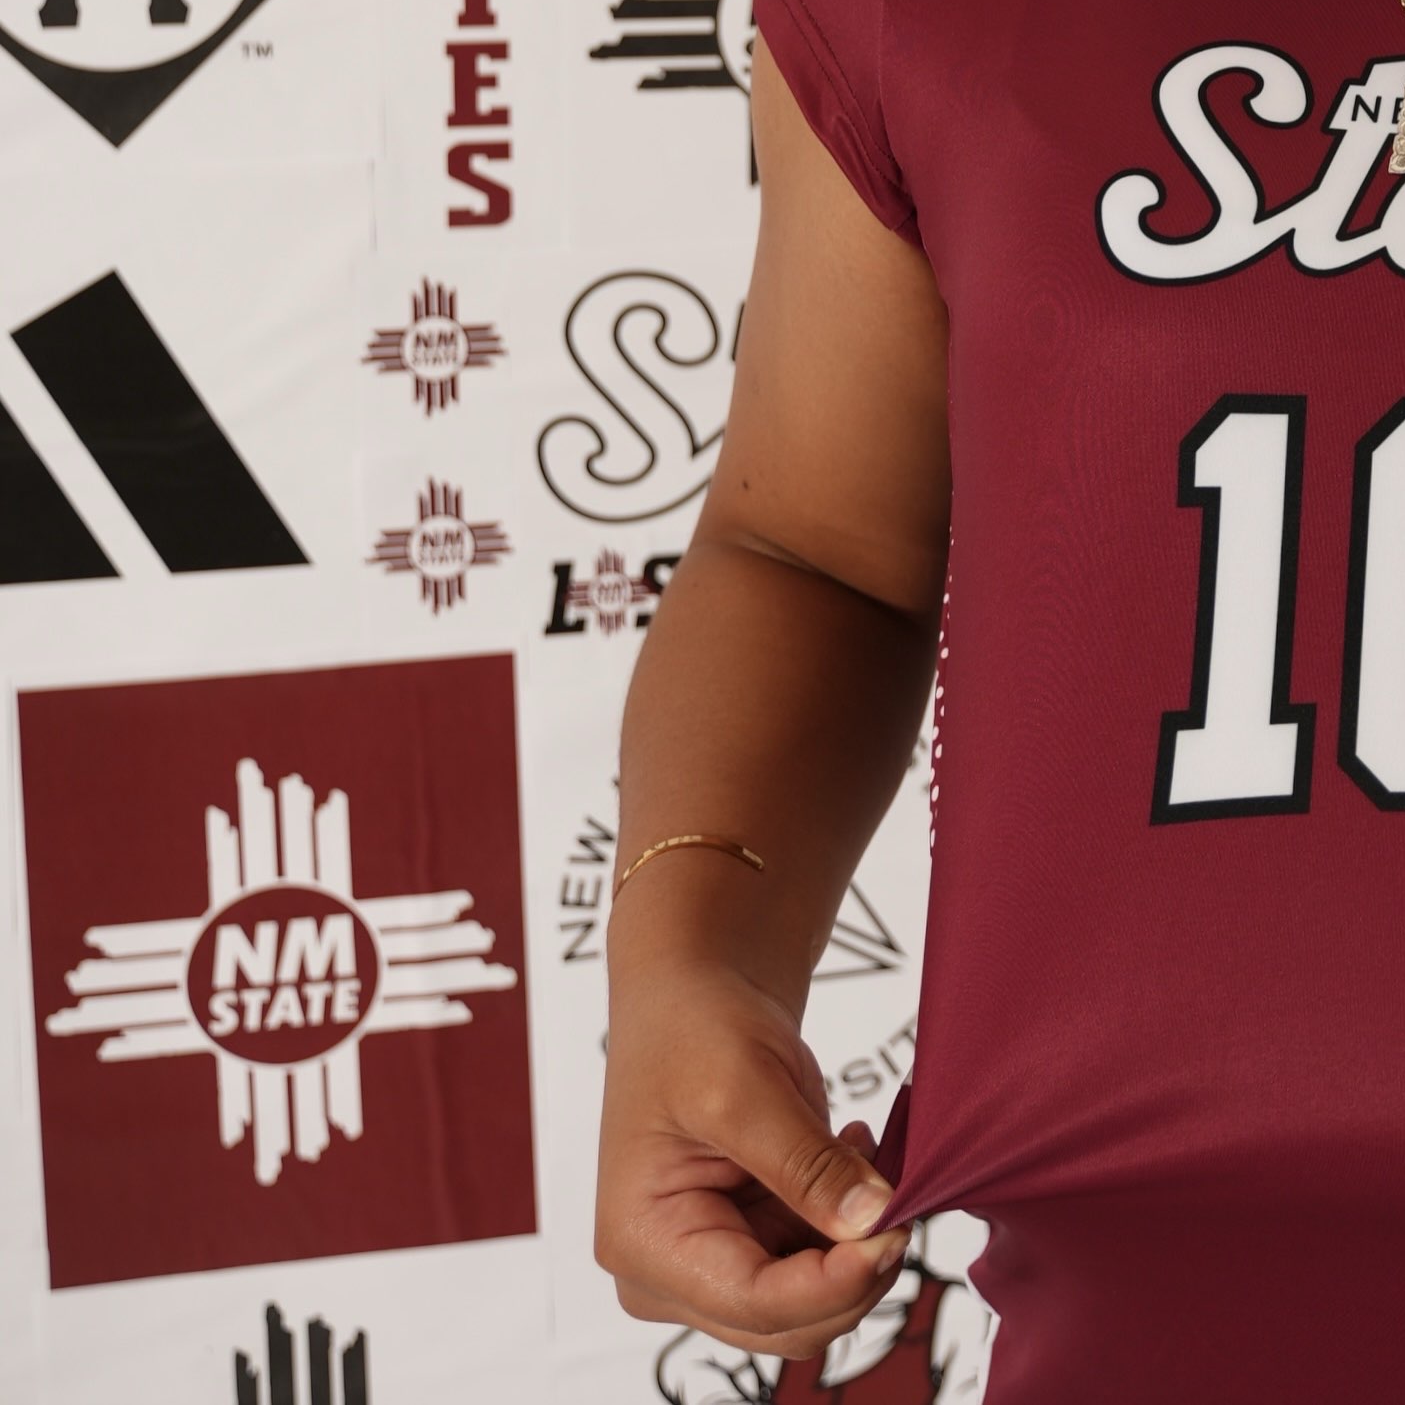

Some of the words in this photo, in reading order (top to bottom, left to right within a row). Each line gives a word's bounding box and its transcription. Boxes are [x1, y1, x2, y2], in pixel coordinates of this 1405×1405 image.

[559, 814, 616, 965] NEW
[213, 913, 358, 990] NM
[207, 979, 362, 1038] STATE
